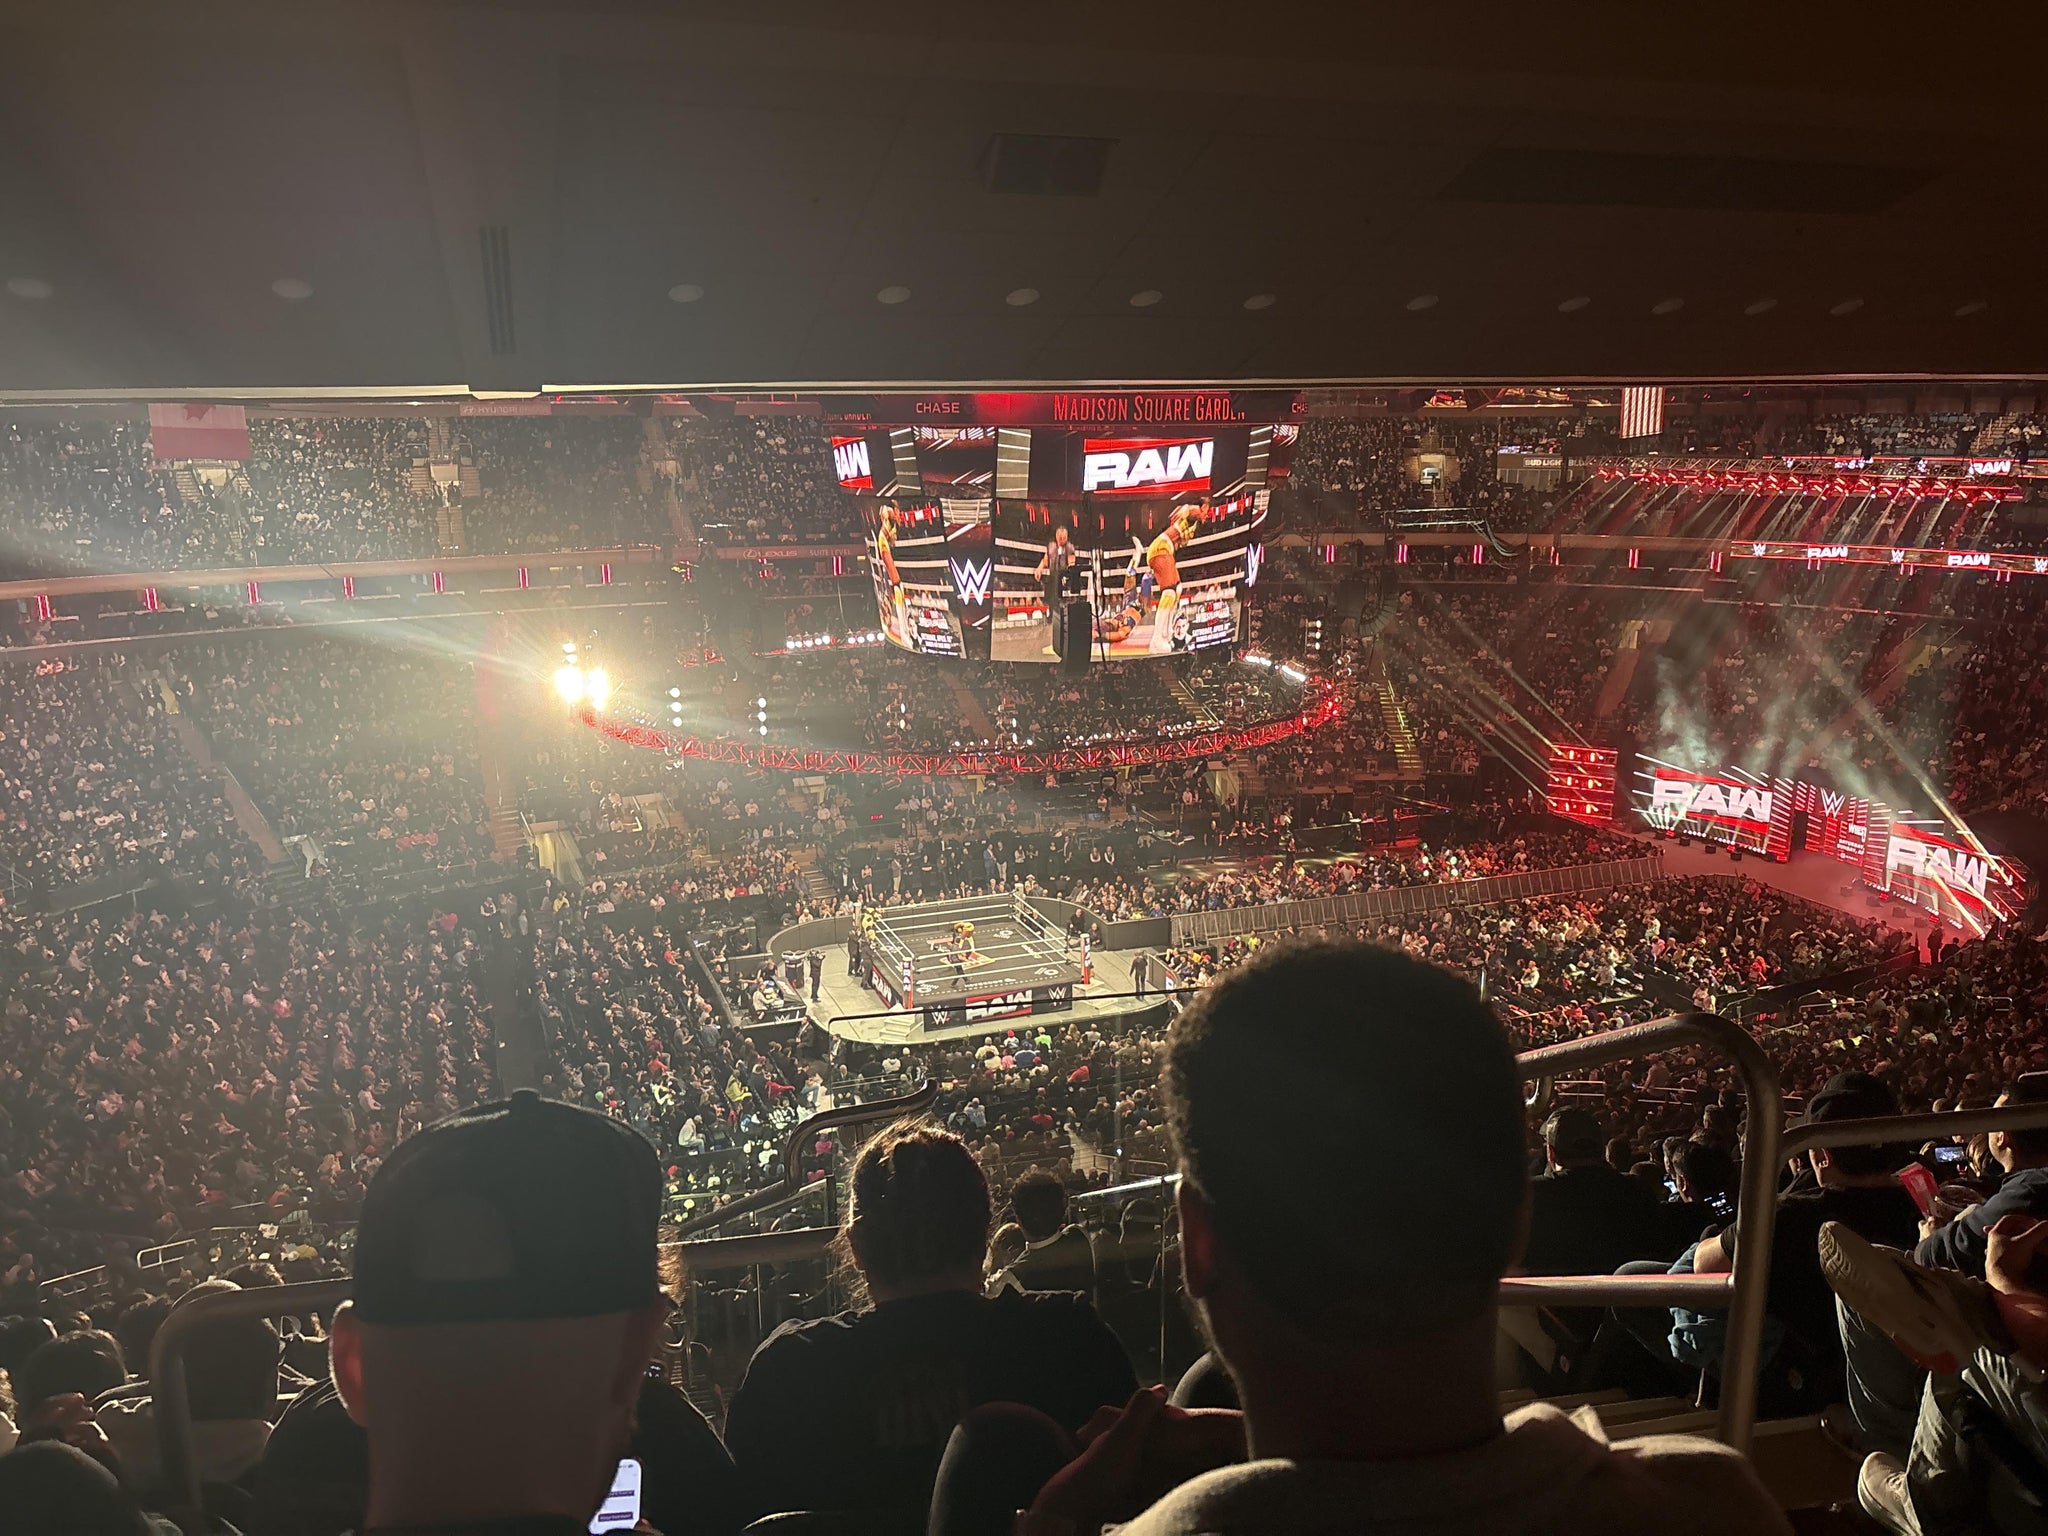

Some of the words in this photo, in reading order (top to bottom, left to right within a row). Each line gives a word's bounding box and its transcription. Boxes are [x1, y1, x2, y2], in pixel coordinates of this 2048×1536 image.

[916, 402, 960, 413] CHASE
[1054, 395, 1128, 421] MADISON
[1134, 395, 1191, 423] SQUARE
[1083, 441, 1214, 491] RAW
[1968, 460, 2011, 475] RAW
[758, 549, 798, 558] LEXUS
[809, 549, 829, 557] SUITE
[830, 548, 851, 557] LEVEL
[1807, 545, 1848, 559] RAW
[1947, 553, 1990, 566] RAW
[1653, 780, 1773, 823] RAW
[1886, 835, 1989, 897] RAW
[872, 969, 892, 1003] RAW
[966, 989, 1033, 1021] RAW
